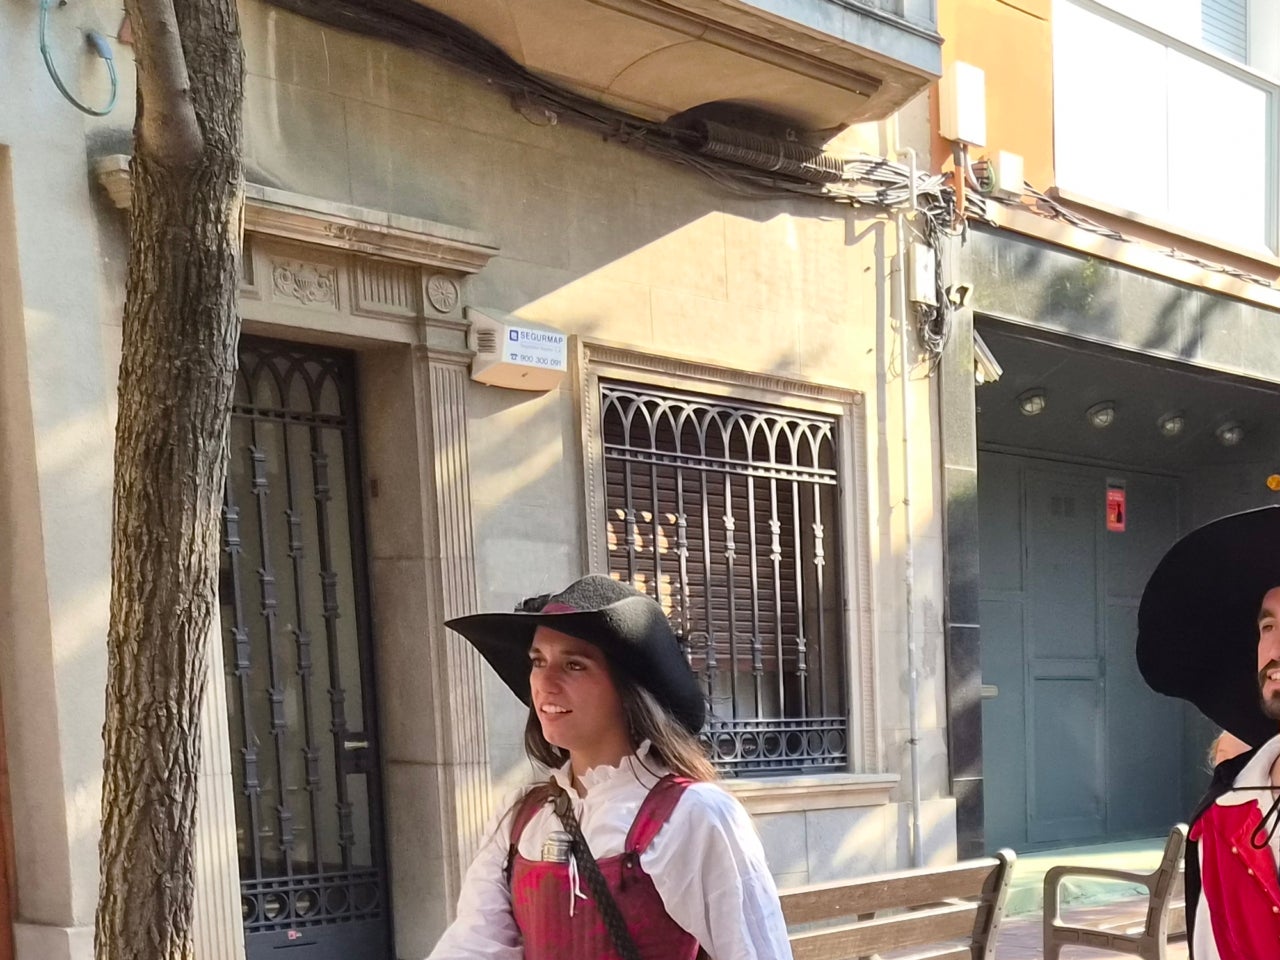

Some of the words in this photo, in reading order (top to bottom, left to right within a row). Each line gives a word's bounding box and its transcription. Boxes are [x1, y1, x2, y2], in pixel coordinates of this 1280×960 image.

[520, 331, 563, 344] SEGURMAP
[520, 354, 534, 363] 900
[536, 357, 549, 365] 300
